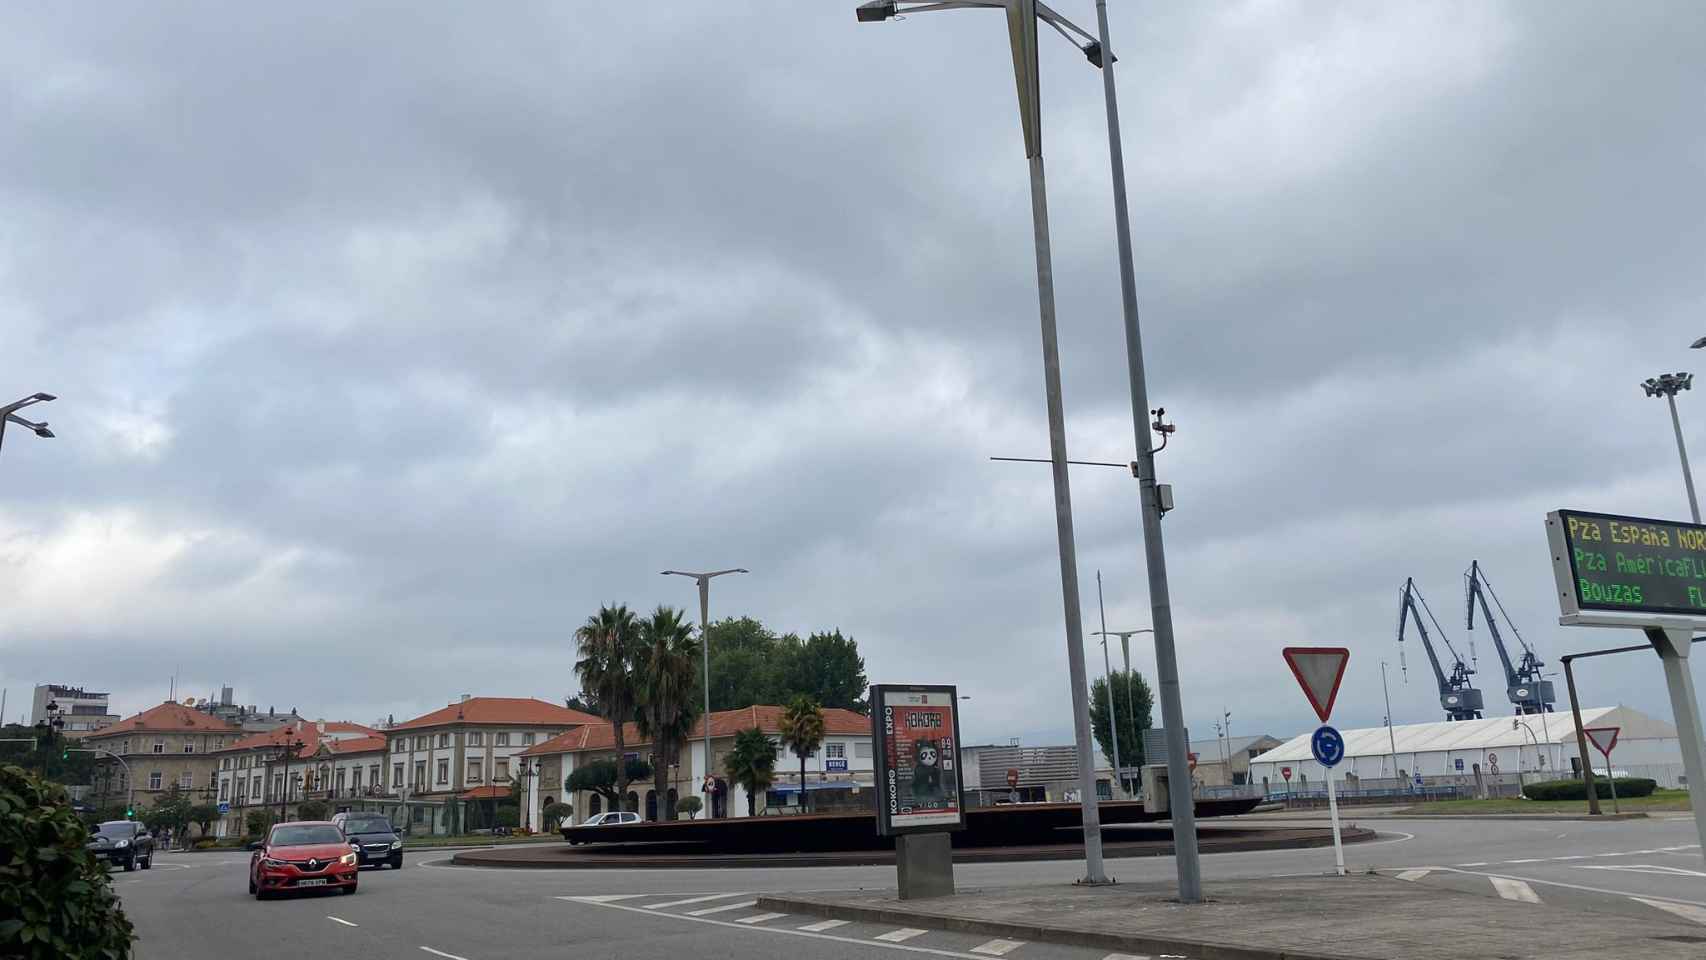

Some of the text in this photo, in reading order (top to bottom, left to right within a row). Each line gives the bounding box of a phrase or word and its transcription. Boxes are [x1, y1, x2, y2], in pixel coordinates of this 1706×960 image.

[1568, 517, 1602, 541] Pza
[1610, 522, 1671, 547] España
[1573, 546, 1607, 572] Pza
[1579, 577, 1643, 604] Bouzas
[885, 707, 893, 735] EXPO
[888, 769, 897, 814] KOKORO
